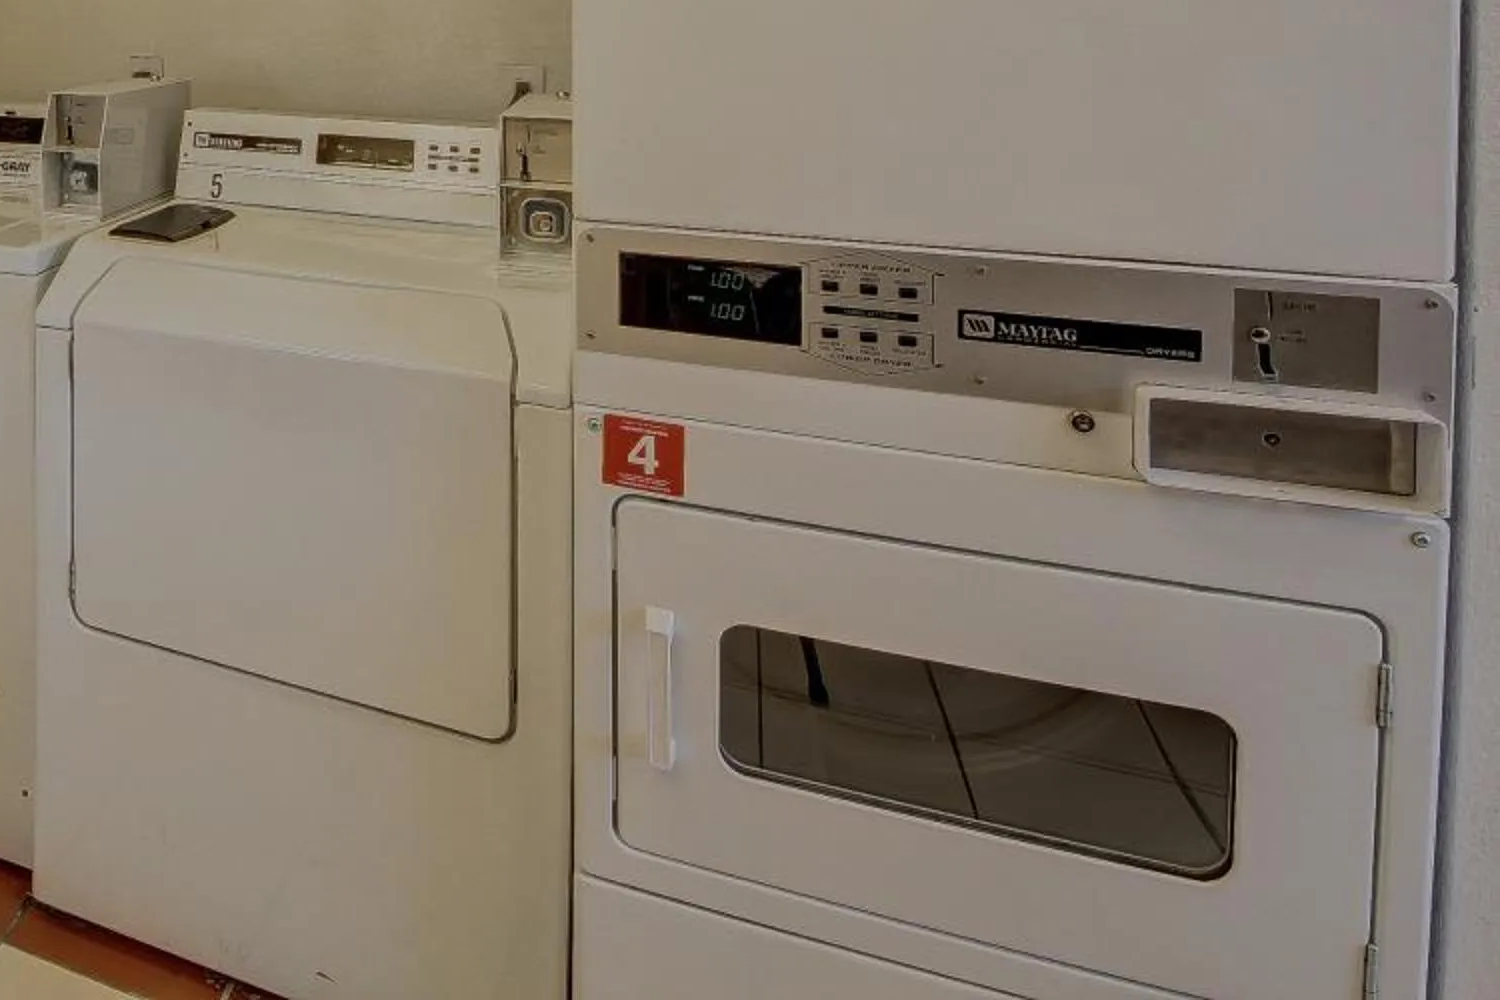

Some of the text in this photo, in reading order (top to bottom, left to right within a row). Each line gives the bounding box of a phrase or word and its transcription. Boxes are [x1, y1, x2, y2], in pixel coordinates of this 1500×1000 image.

[211, 173, 223, 198] 5
[997, 321, 1078, 343] MAYTAG
[628, 435, 659, 475] 4
